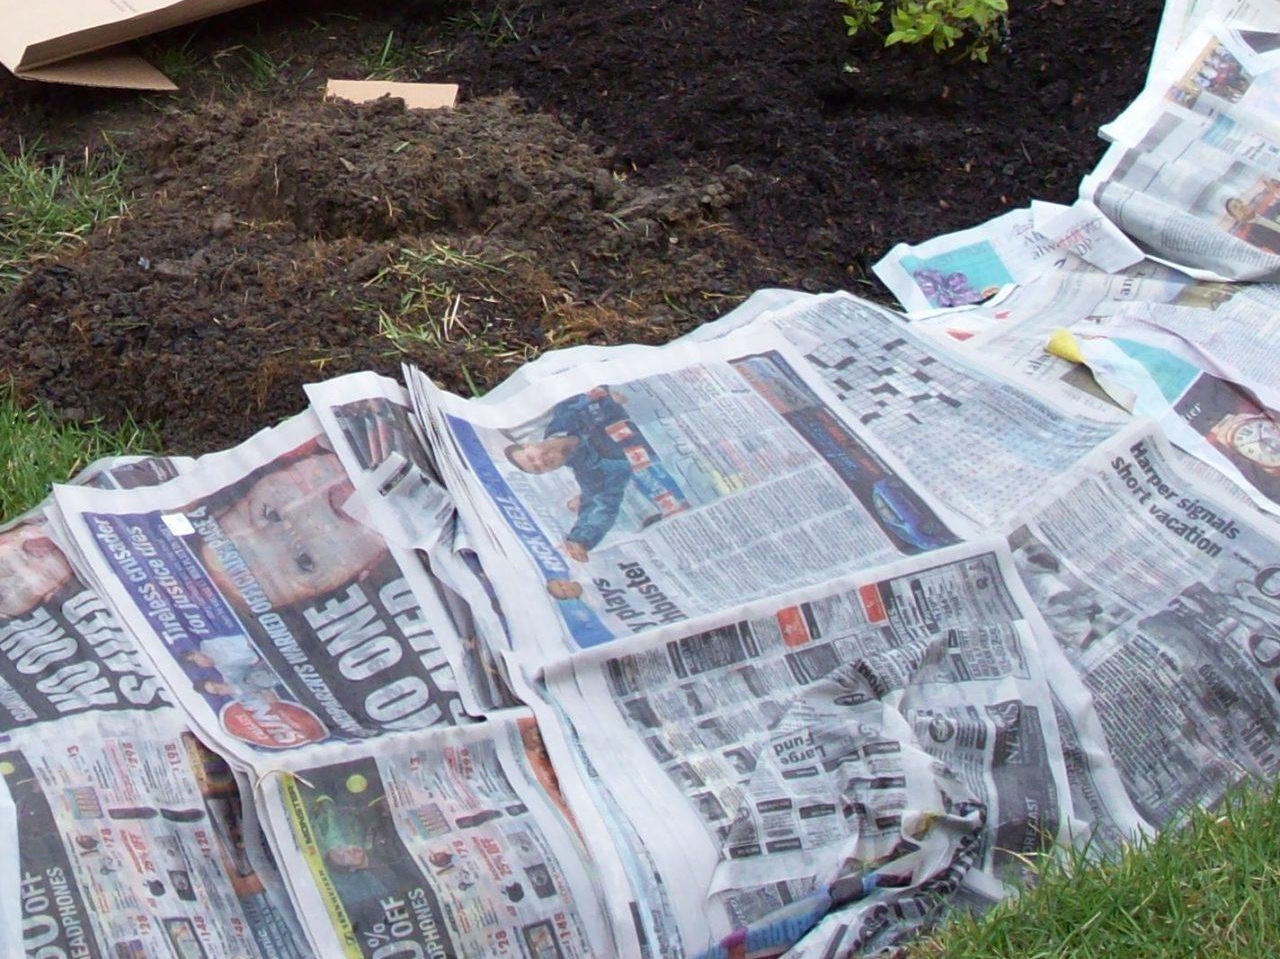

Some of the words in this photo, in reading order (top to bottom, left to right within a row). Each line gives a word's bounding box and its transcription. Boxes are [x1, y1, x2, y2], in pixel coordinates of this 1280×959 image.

[186, 505, 208, 520] 4
[1111, 456, 1153, 506] short
[1149, 504, 1223, 558] vacation
[1130, 440, 1180, 501] Harper
[1176, 497, 1241, 540] signals
[194, 514, 226, 553] PAGE
[495, 495, 537, 537] BELL
[93, 516, 148, 582] crusader
[126, 525, 158, 557] dies
[530, 535, 566, 574] RICK
[148, 558, 200, 610] justice
[592, 576, 646, 622] plays
[138, 582, 189, 645] Tireless
[185, 611, 211, 635] for
[302, 582, 403, 682] ONE
[257, 612, 309, 667] WARNED
[35, 661, 120, 715] NO
[772, 728, 814, 756] Fund
[779, 743, 827, 768] Large
[379, 895, 415, 939] OFF
